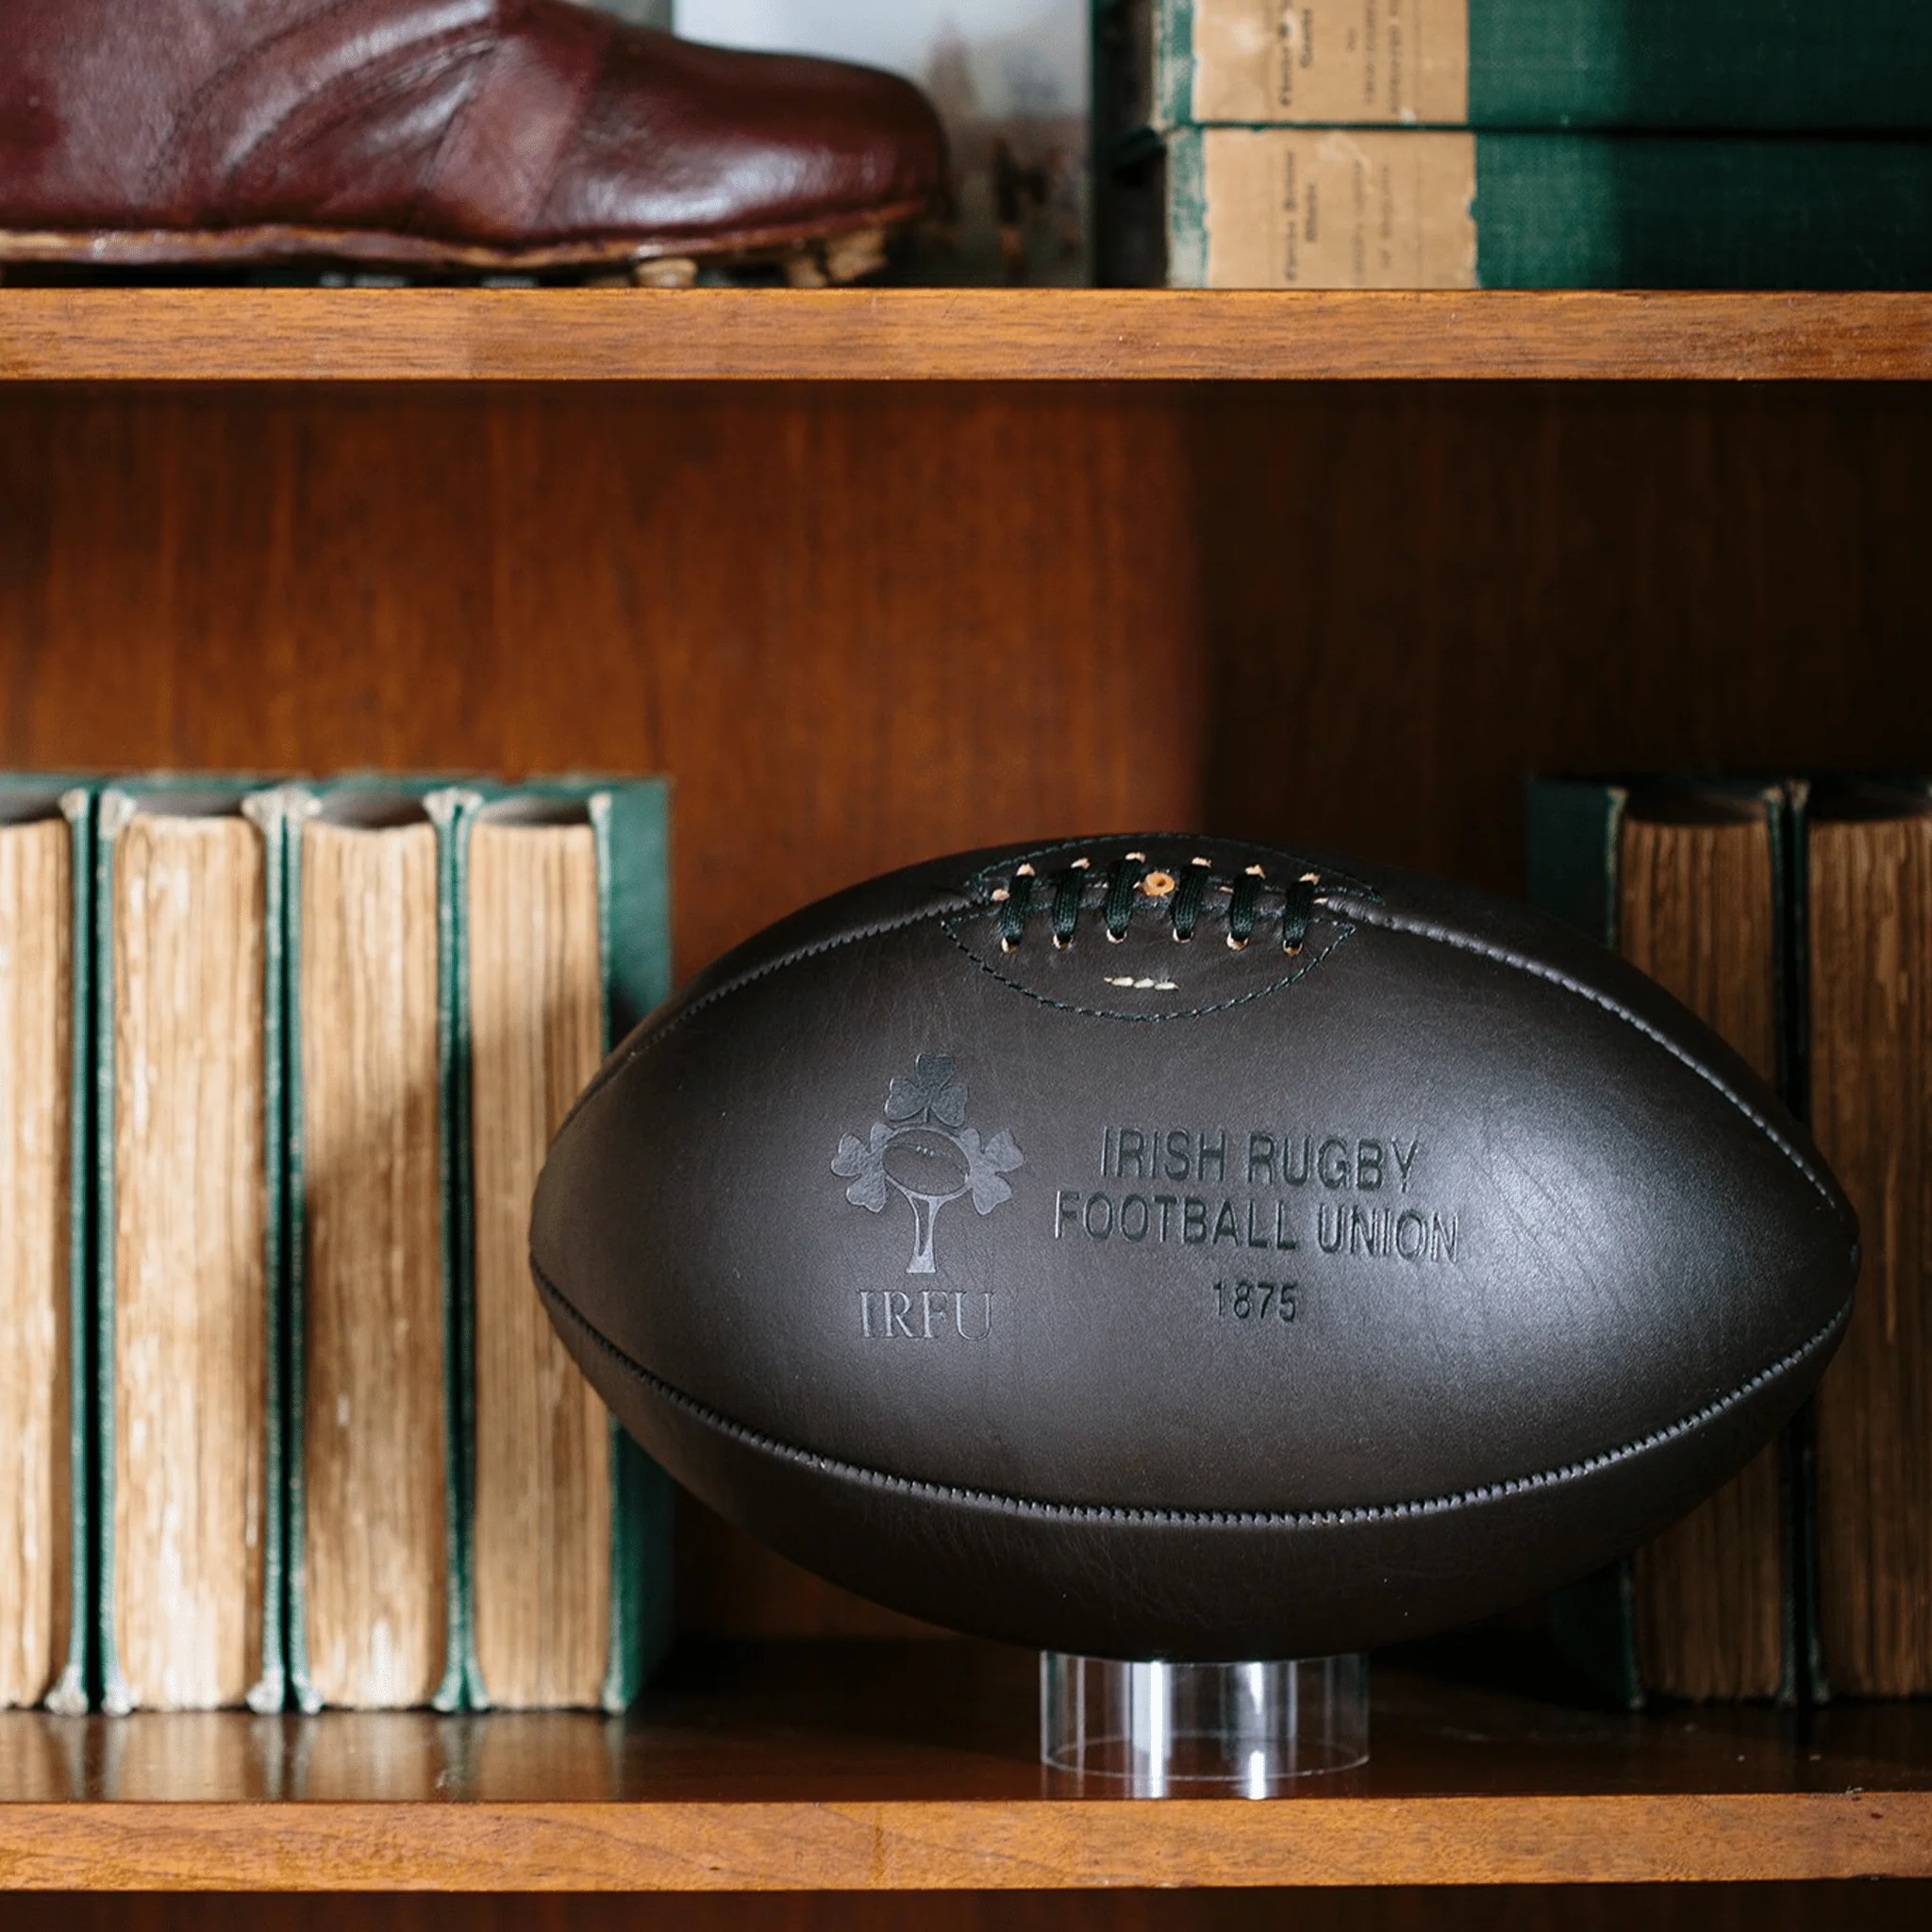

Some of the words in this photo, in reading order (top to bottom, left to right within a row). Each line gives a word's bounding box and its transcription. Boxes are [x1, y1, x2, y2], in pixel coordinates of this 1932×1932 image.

[1100, 1126, 1225, 1180] IRISH
[1247, 1134, 1419, 1193] RUGBY
[1055, 1190, 1297, 1250] FOOTBALL
[1318, 1204, 1458, 1263] UNION
[856, 1290, 995, 1341] IRFU
[1213, 1278, 1298, 1322] 1875
